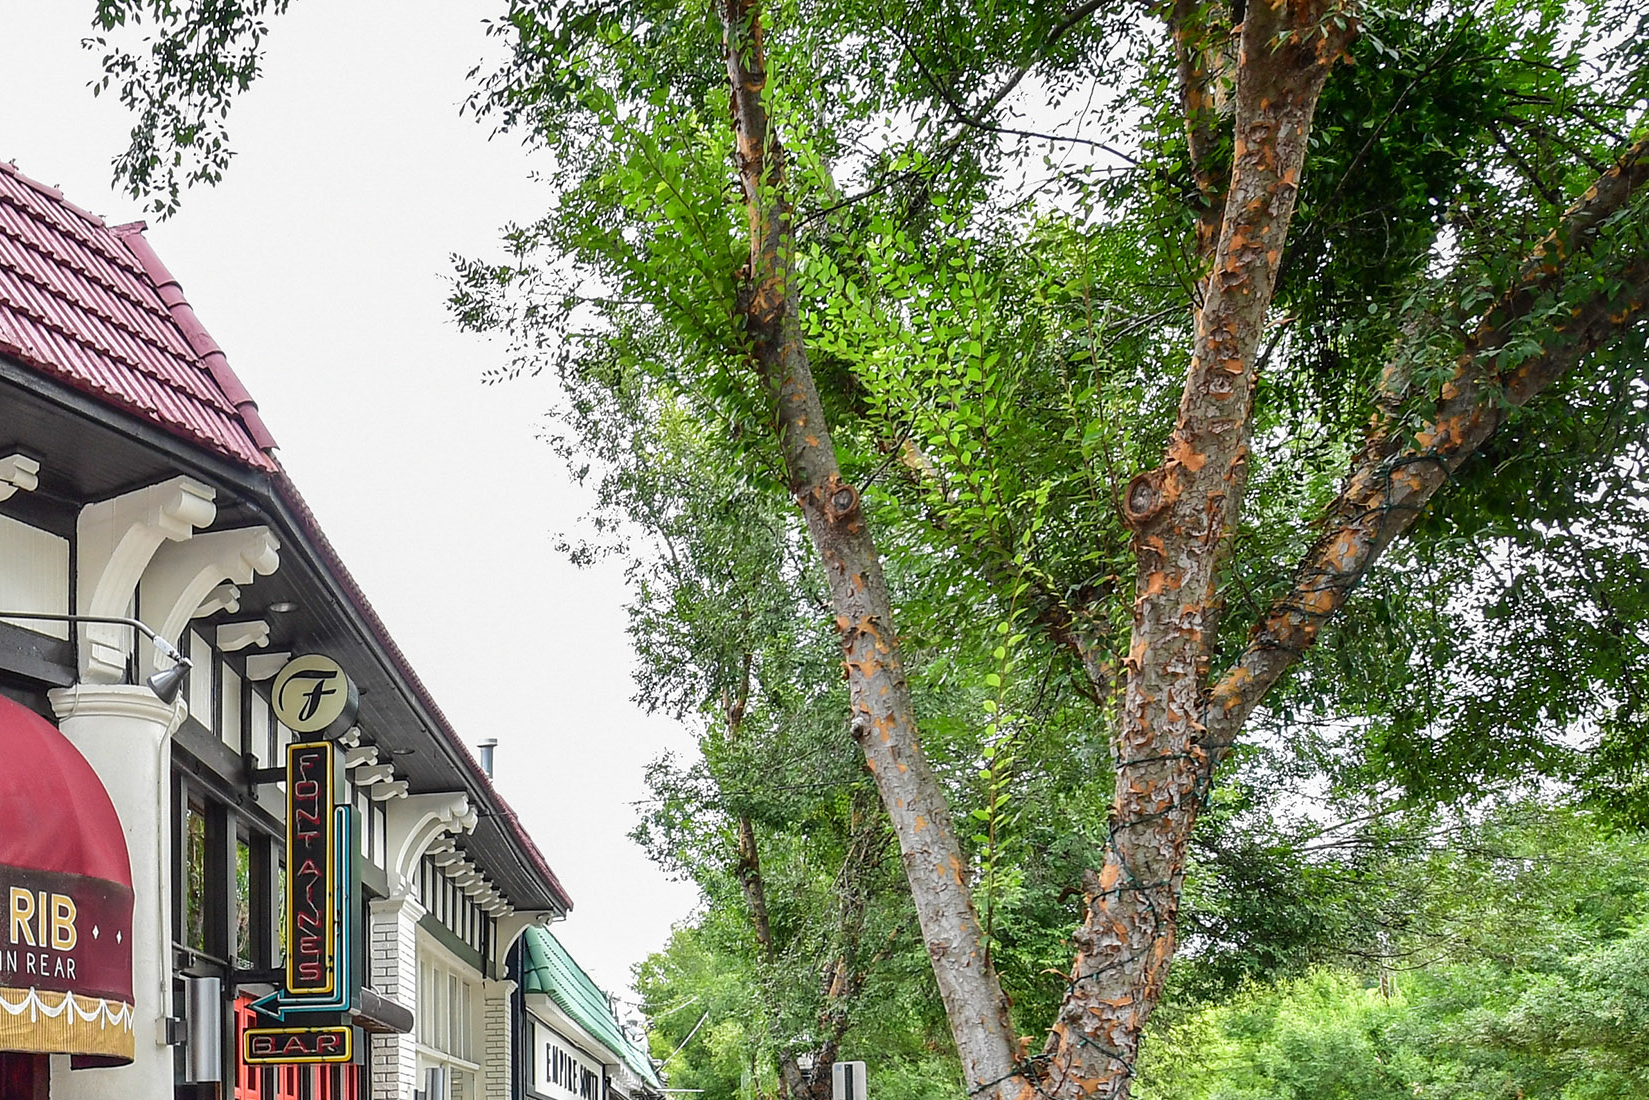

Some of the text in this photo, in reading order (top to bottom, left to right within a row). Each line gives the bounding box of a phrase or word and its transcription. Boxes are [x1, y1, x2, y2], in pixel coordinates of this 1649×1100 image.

[294, 752, 323, 983] FONTAINES
[8, 886, 78, 951] RIB
[0, 950, 18, 973] IN
[27, 950, 77, 980] REAR
[251, 1034, 341, 1055] BAR
[546, 1042, 577, 1095] EMPIRE
